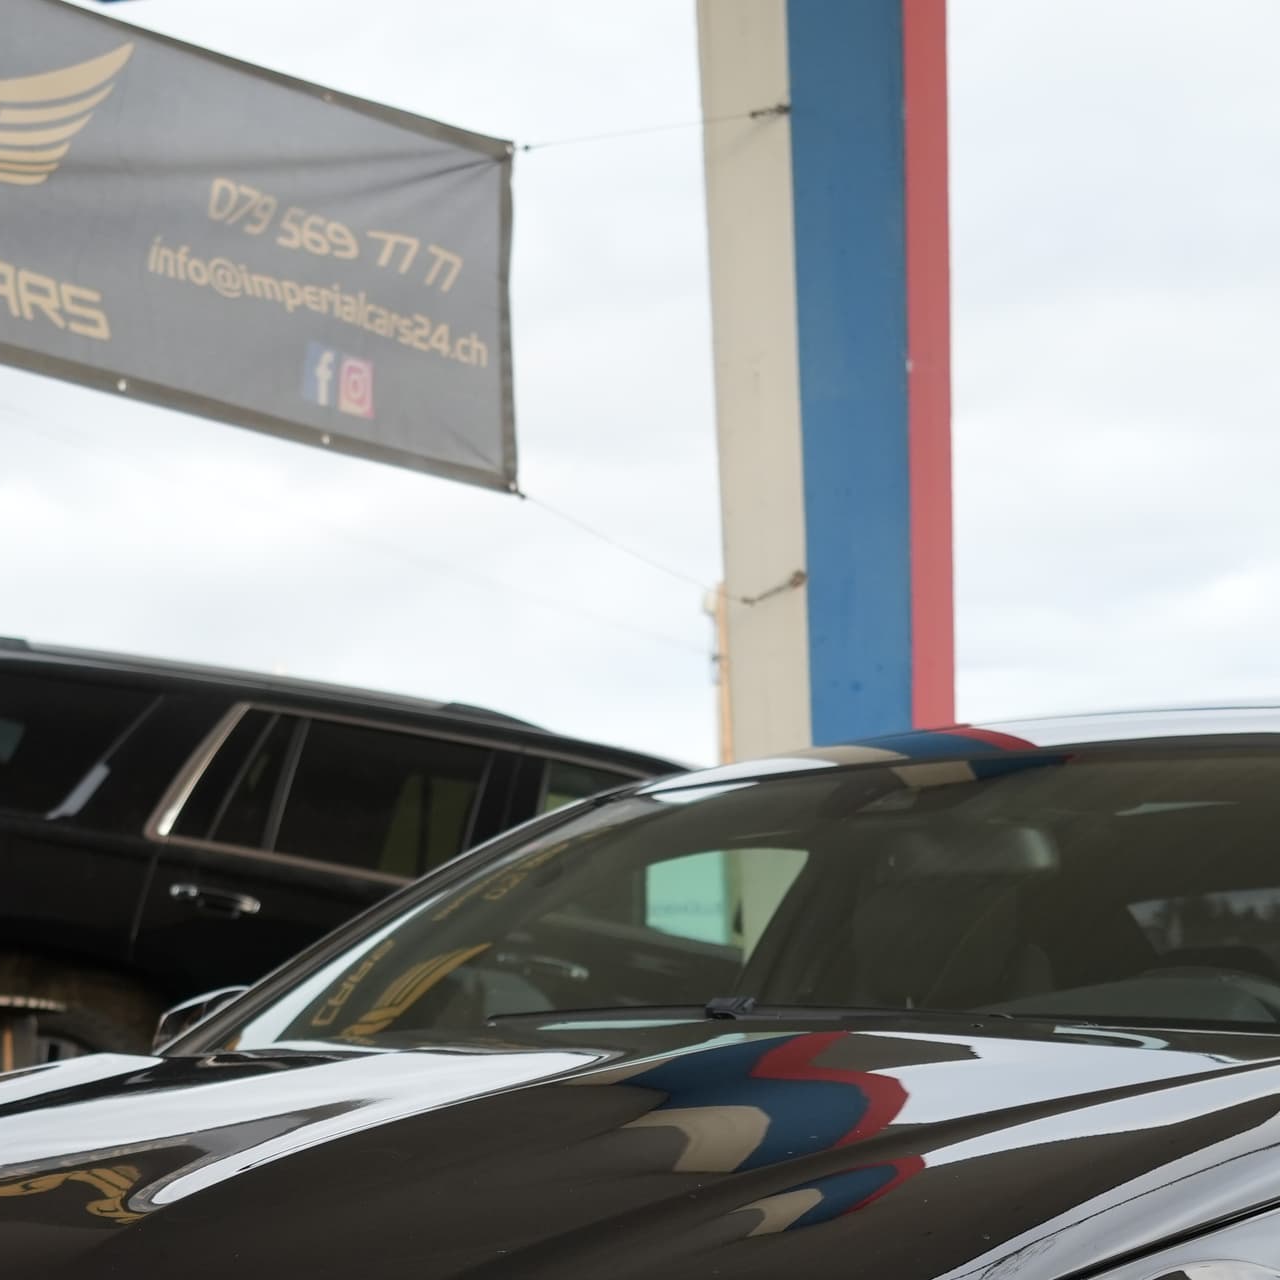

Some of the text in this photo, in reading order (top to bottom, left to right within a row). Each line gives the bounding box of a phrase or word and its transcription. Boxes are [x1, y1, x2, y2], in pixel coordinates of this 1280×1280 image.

[207, 177, 277, 235] 079
[277, 207, 360, 260] 569
[148, 235, 489, 368] info@imperialcars24.ch
